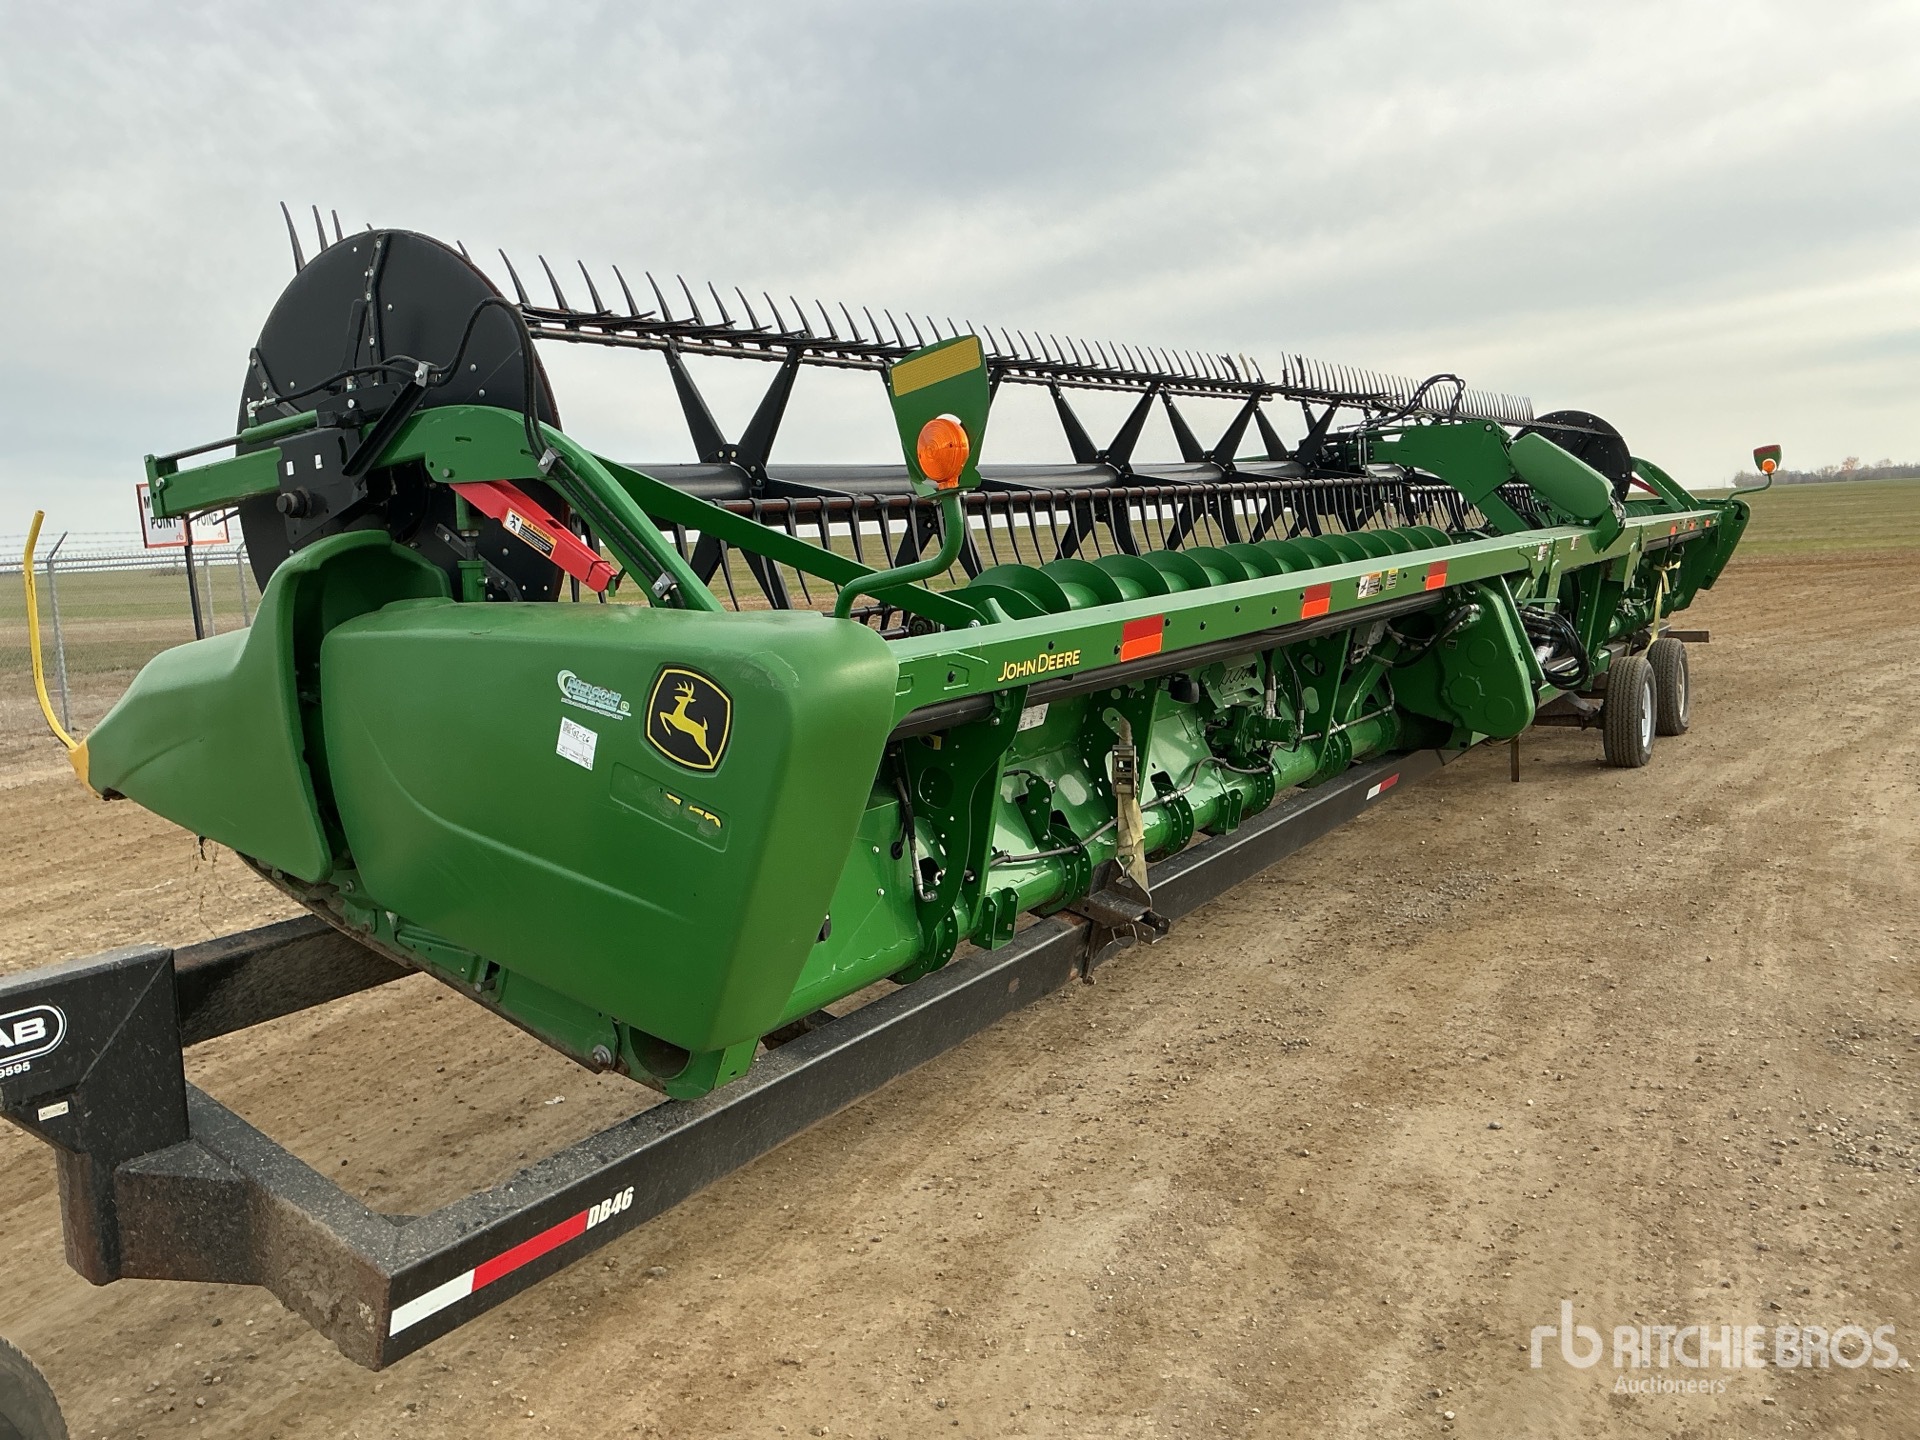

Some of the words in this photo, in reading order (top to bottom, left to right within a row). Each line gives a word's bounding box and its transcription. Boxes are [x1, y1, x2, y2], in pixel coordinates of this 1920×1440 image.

[150, 517, 177, 530] POINT
[998, 659, 1036, 682] JOHN
[1037, 649, 1081, 673] DEERE
[586, 1186, 635, 1231] DB46
